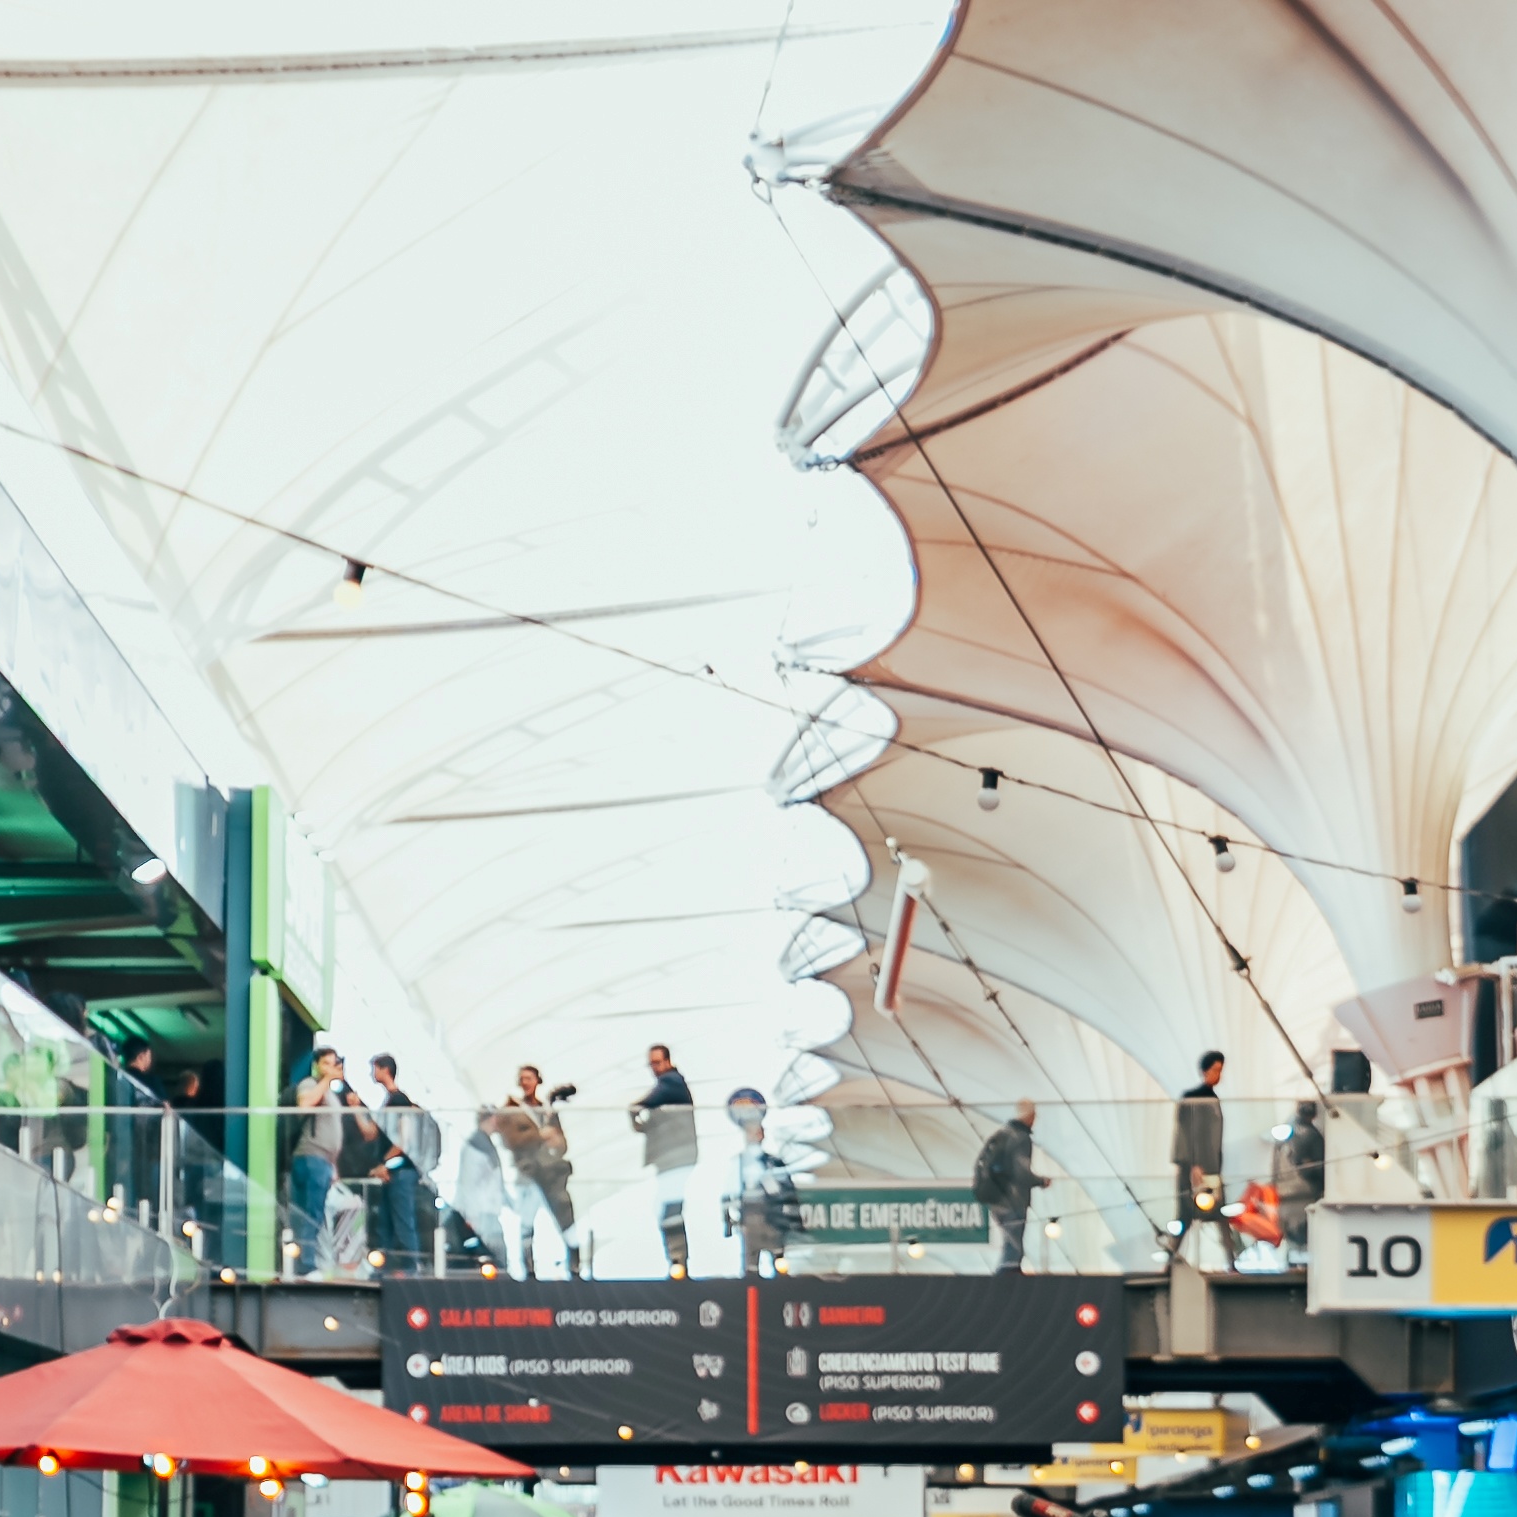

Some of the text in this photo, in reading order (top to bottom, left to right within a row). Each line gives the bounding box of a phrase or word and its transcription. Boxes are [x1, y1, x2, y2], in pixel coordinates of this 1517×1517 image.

[833, 1203, 855, 1229] DE
[859, 1198, 983, 1229] EMERGÊNCIA
[1346, 1235, 1423, 1279] 10
[599, 1309, 680, 1328] SUPERIOR)
[553, 1358, 633, 1377] SUPERIOR)
[818, 1352, 935, 1374] CREDENCIAMENTO
[936, 1352, 967, 1373] TEST
[861, 1375, 944, 1392] SUPERIOR)
[915, 1405, 998, 1423] SUPERIOR)
[655, 1464, 859, 1485] Kawasaki
[662, 1495, 687, 1509] Let
[692, 1495, 718, 1509] the
[721, 1495, 764, 1509] Good
[769, 1495, 815, 1509] Times
